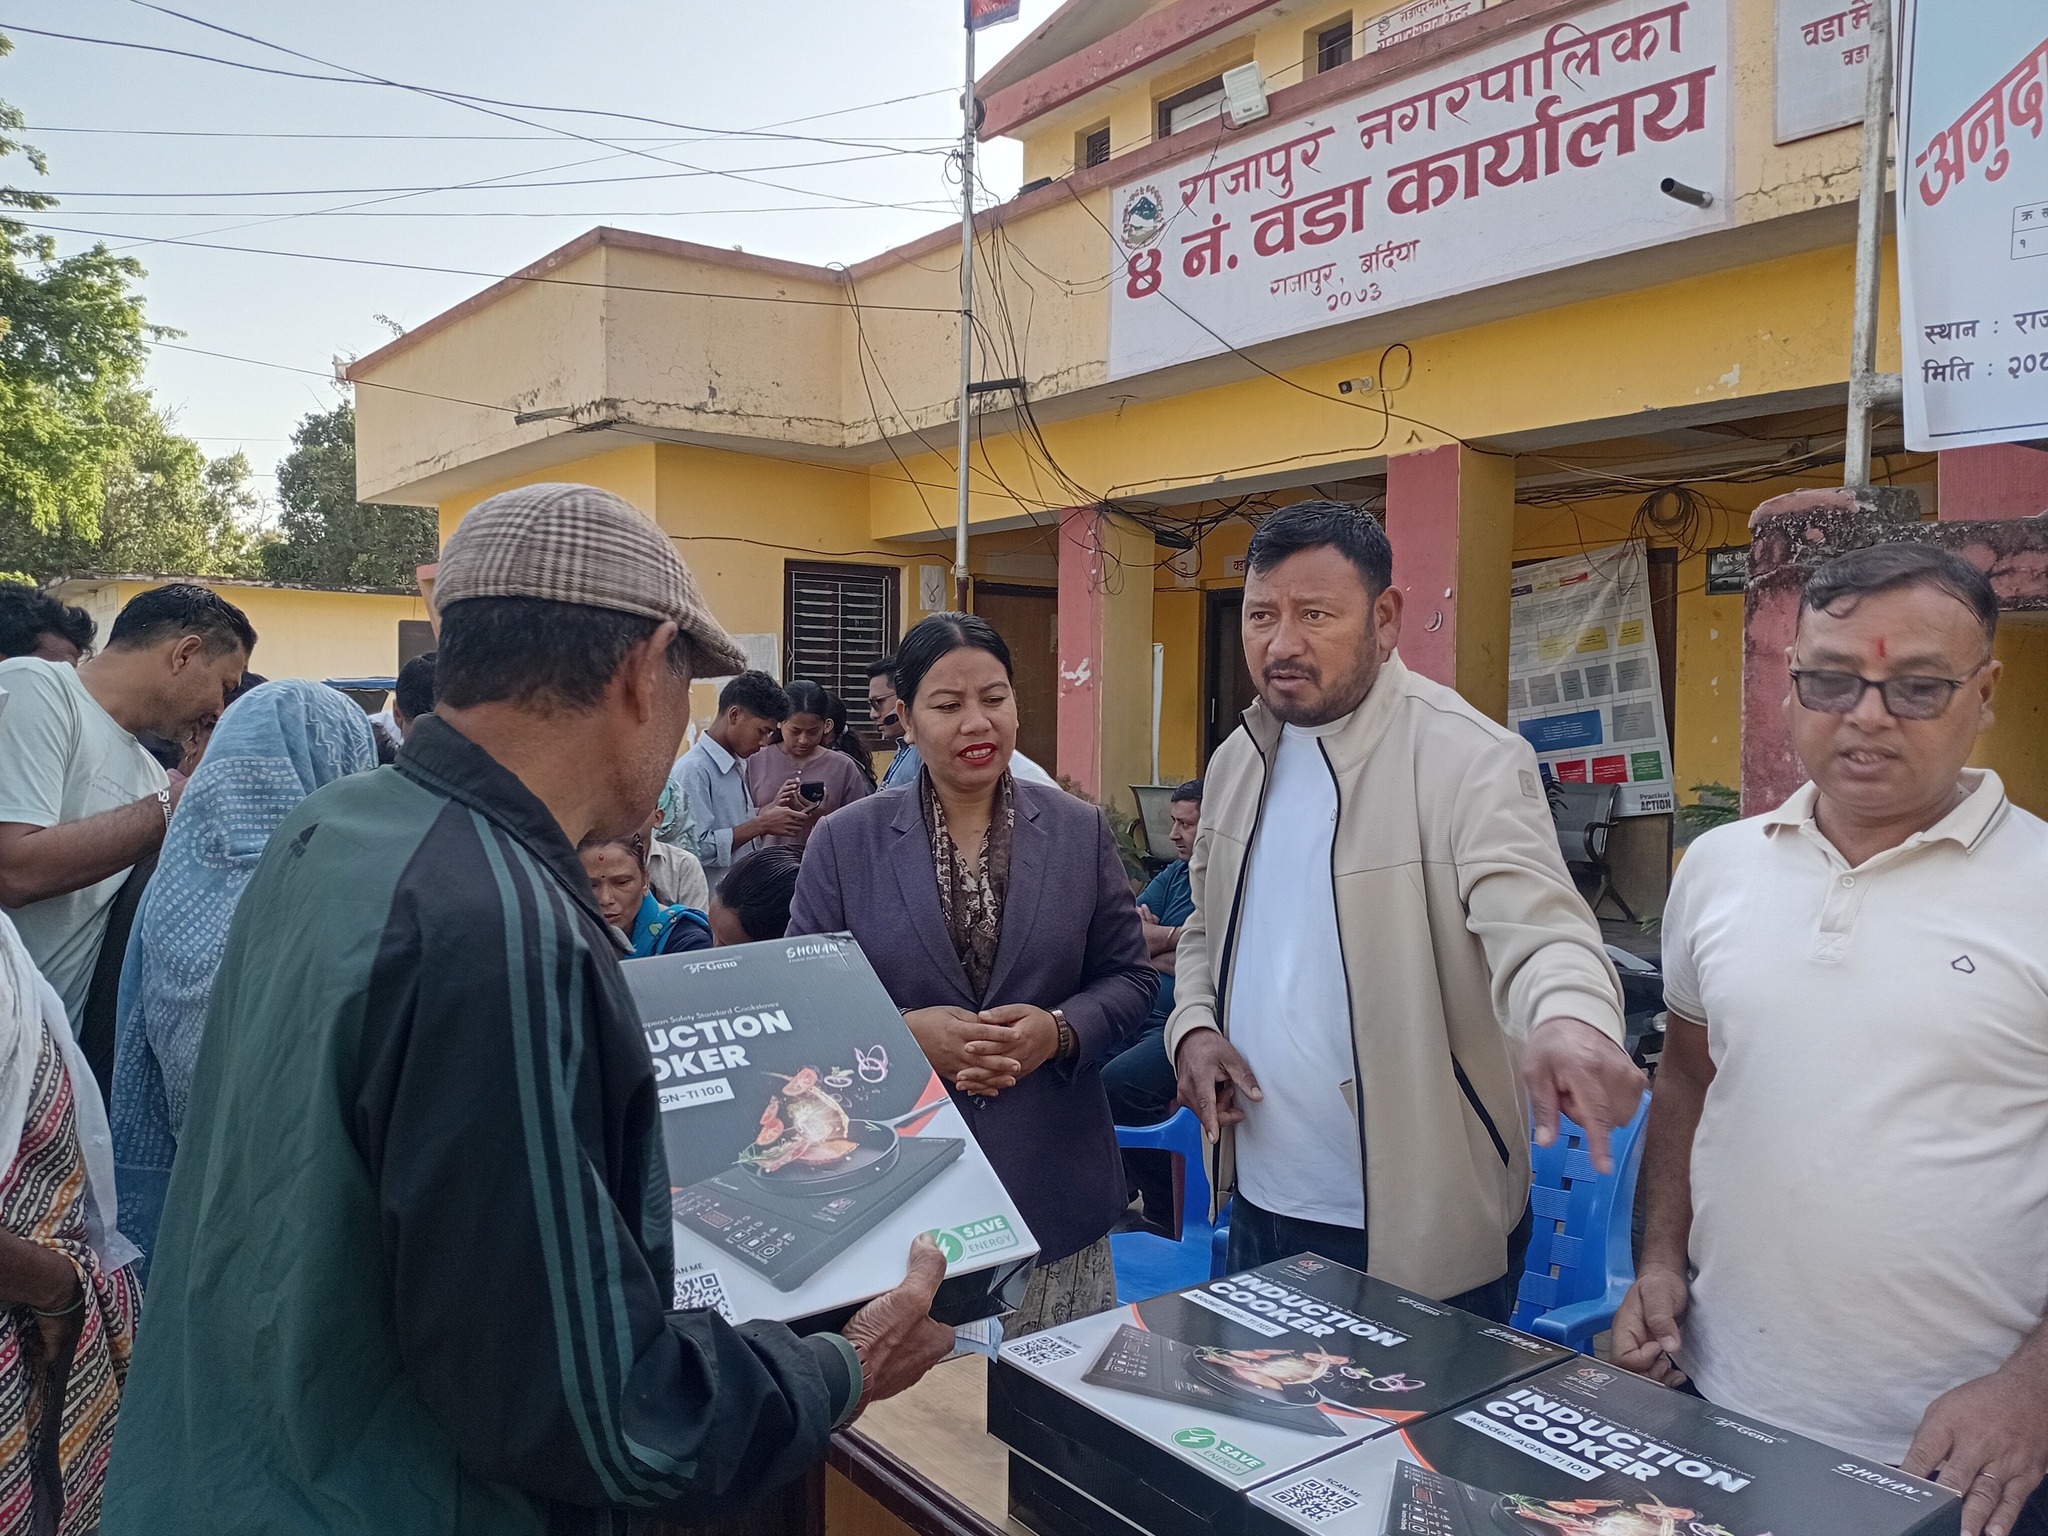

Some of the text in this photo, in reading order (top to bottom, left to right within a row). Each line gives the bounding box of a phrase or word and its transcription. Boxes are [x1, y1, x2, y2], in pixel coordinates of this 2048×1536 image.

[1800, 0, 1873, 46] वडा मे
[1178, 1, 1690, 217] राजापुर नगरपालिका
[1915, 37, 2048, 207] अनुद
[1181, 212, 1238, 278] नं.
[1250, 175, 1372, 257] वडा
[1387, 65, 1717, 216] कार्यालय
[1327, 282, 1382, 312] २०७३
[1924, 319, 1980, 345] स्थान
[1921, 356, 1974, 384] मिति
[1640, 791, 1670, 799] Practical
[1640, 799, 1672, 811] ACTION
[642, 1001, 779, 1029] opean Safety Standard Cookstoves
[644, 1009, 793, 1053] UCTION
[652, 1045, 751, 1082] OKER
[658, 1088, 699, 1104] GN-TI
[962, 1218, 1005, 1238] SAVE
[968, 1234, 1012, 1253] ENERGY
[675, 1262, 703, 1275] AN ME
[1209, 1282, 1336, 1338] COOKER
[1230, 1274, 1407, 1348] INDUCTION
[1466, 1415, 1514, 1440] Model:
[1485, 1401, 1660, 1482] COOKER
[1506, 1389, 1751, 1493] INDUCTION
[1528, 1384, 1559, 1400] Nepal's
[1590, 1411, 1631, 1431] European
[1632, 1428, 1658, 1442] Safety
[1659, 1439, 1703, 1458] Standard
[1702, 1456, 1757, 1479] Cookstoves
[1203, 1450, 1246, 1473] ENERGY
[1219, 1445, 1262, 1468] SAVE
[1325, 1477, 1362, 1498] SCAN ME
[1837, 1463, 1920, 1494] SHOVAN
